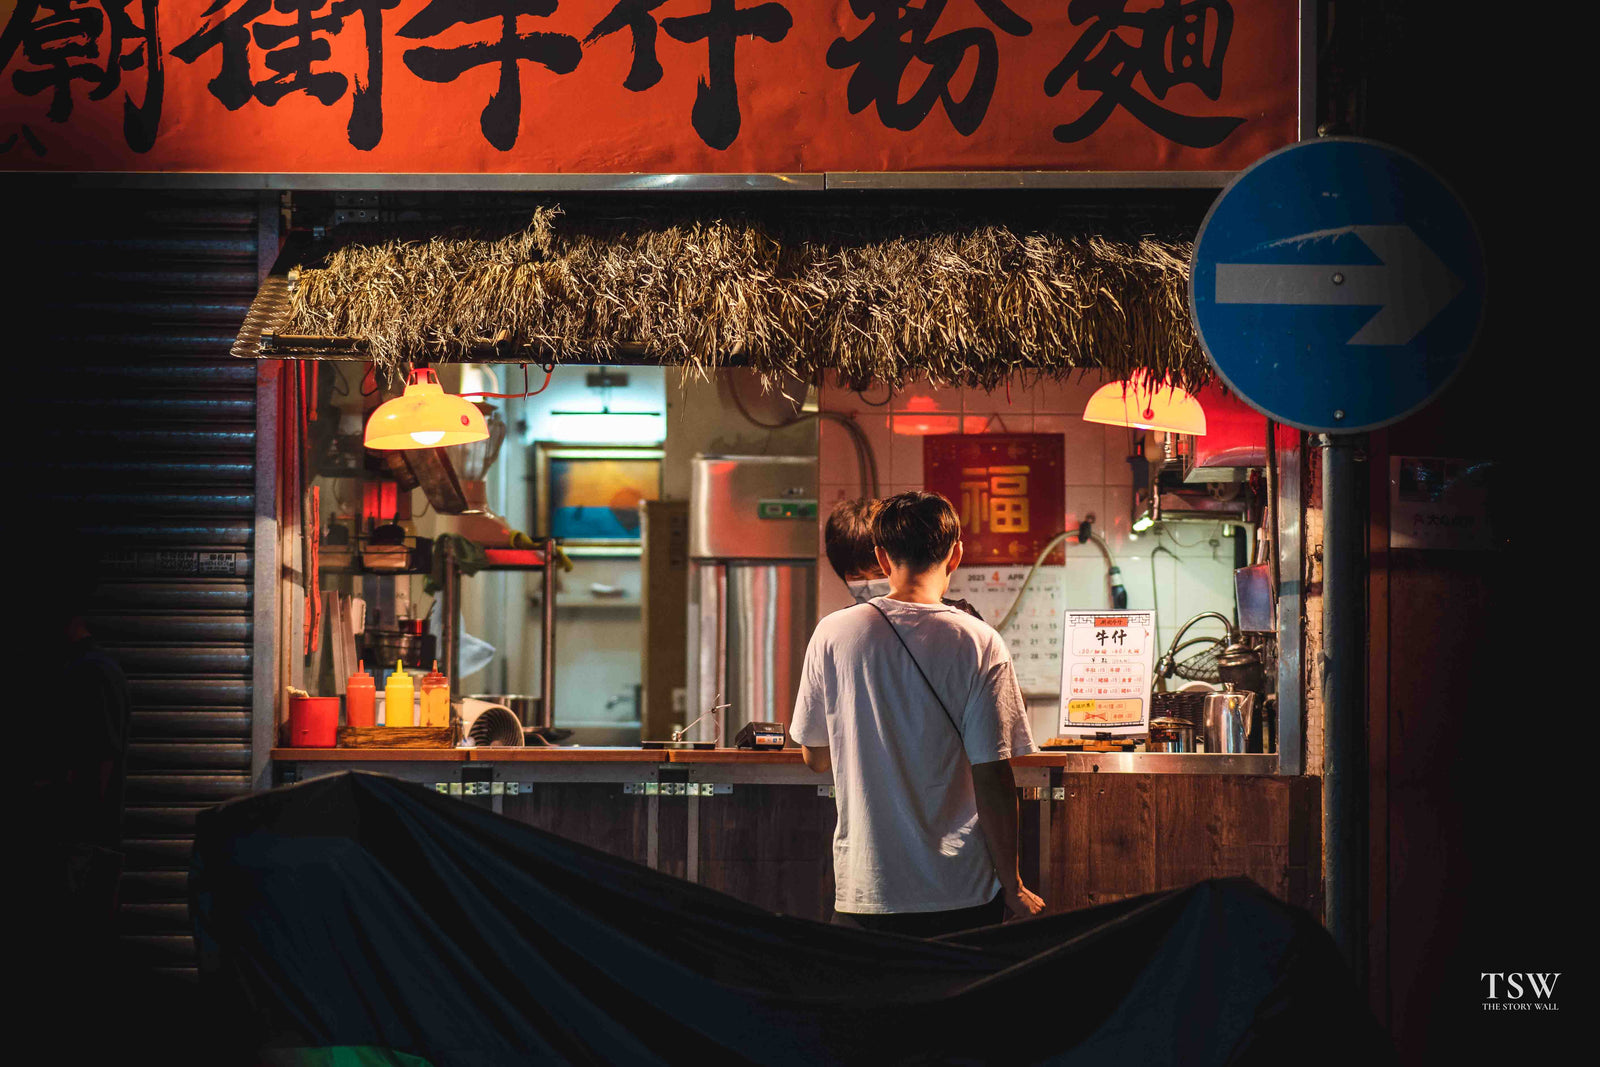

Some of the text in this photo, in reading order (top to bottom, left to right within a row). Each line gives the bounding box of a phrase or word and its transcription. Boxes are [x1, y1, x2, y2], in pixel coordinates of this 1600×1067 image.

[961, 465, 1030, 533] 福
[992, 570, 999, 582] 4
[1096, 629, 1127, 647] 牛什
